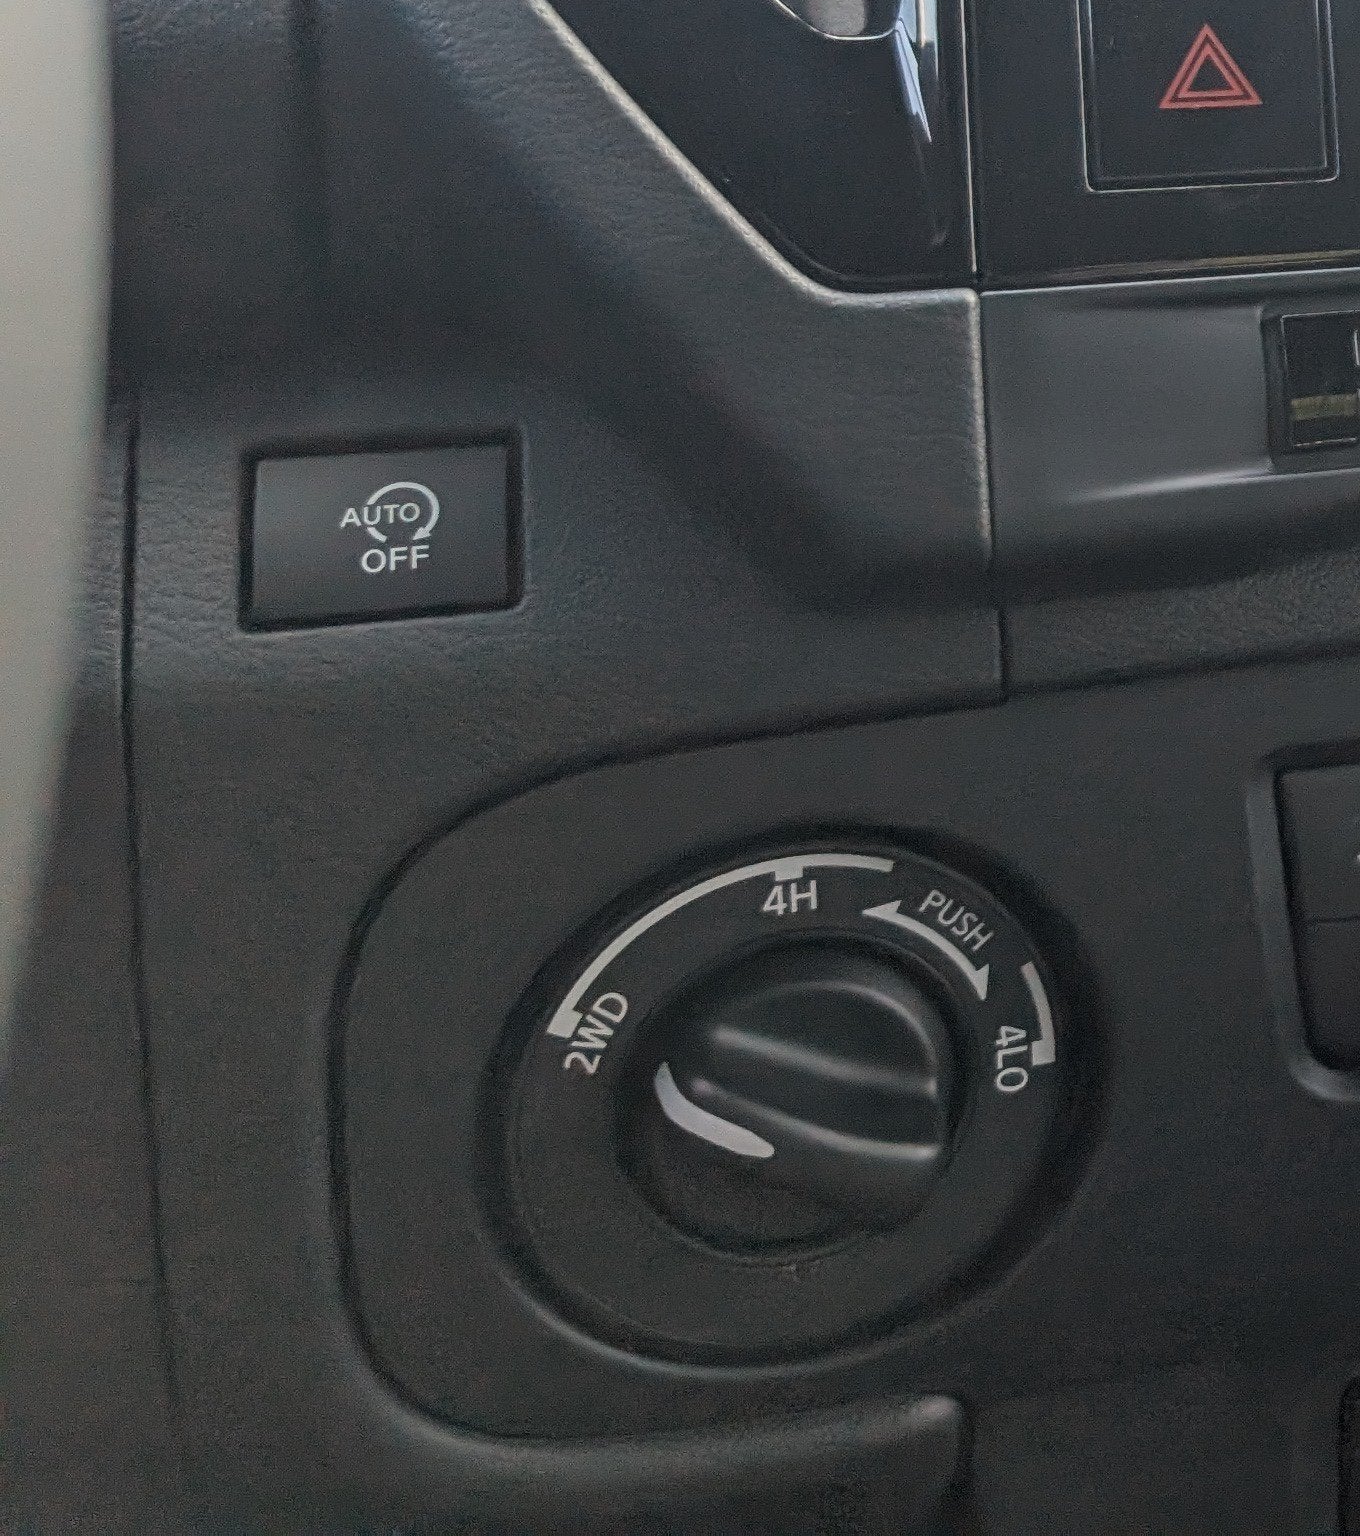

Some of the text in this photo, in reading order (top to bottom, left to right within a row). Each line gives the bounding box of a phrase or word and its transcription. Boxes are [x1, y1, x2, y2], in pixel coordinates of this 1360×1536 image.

[339, 501, 421, 529] AUTO
[360, 543, 430, 574] OFF
[761, 878, 819, 917] 4H
[917, 888, 994, 954] PUSH
[563, 990, 629, 1075] 2WD
[995, 1024, 1030, 1093] 4LO
